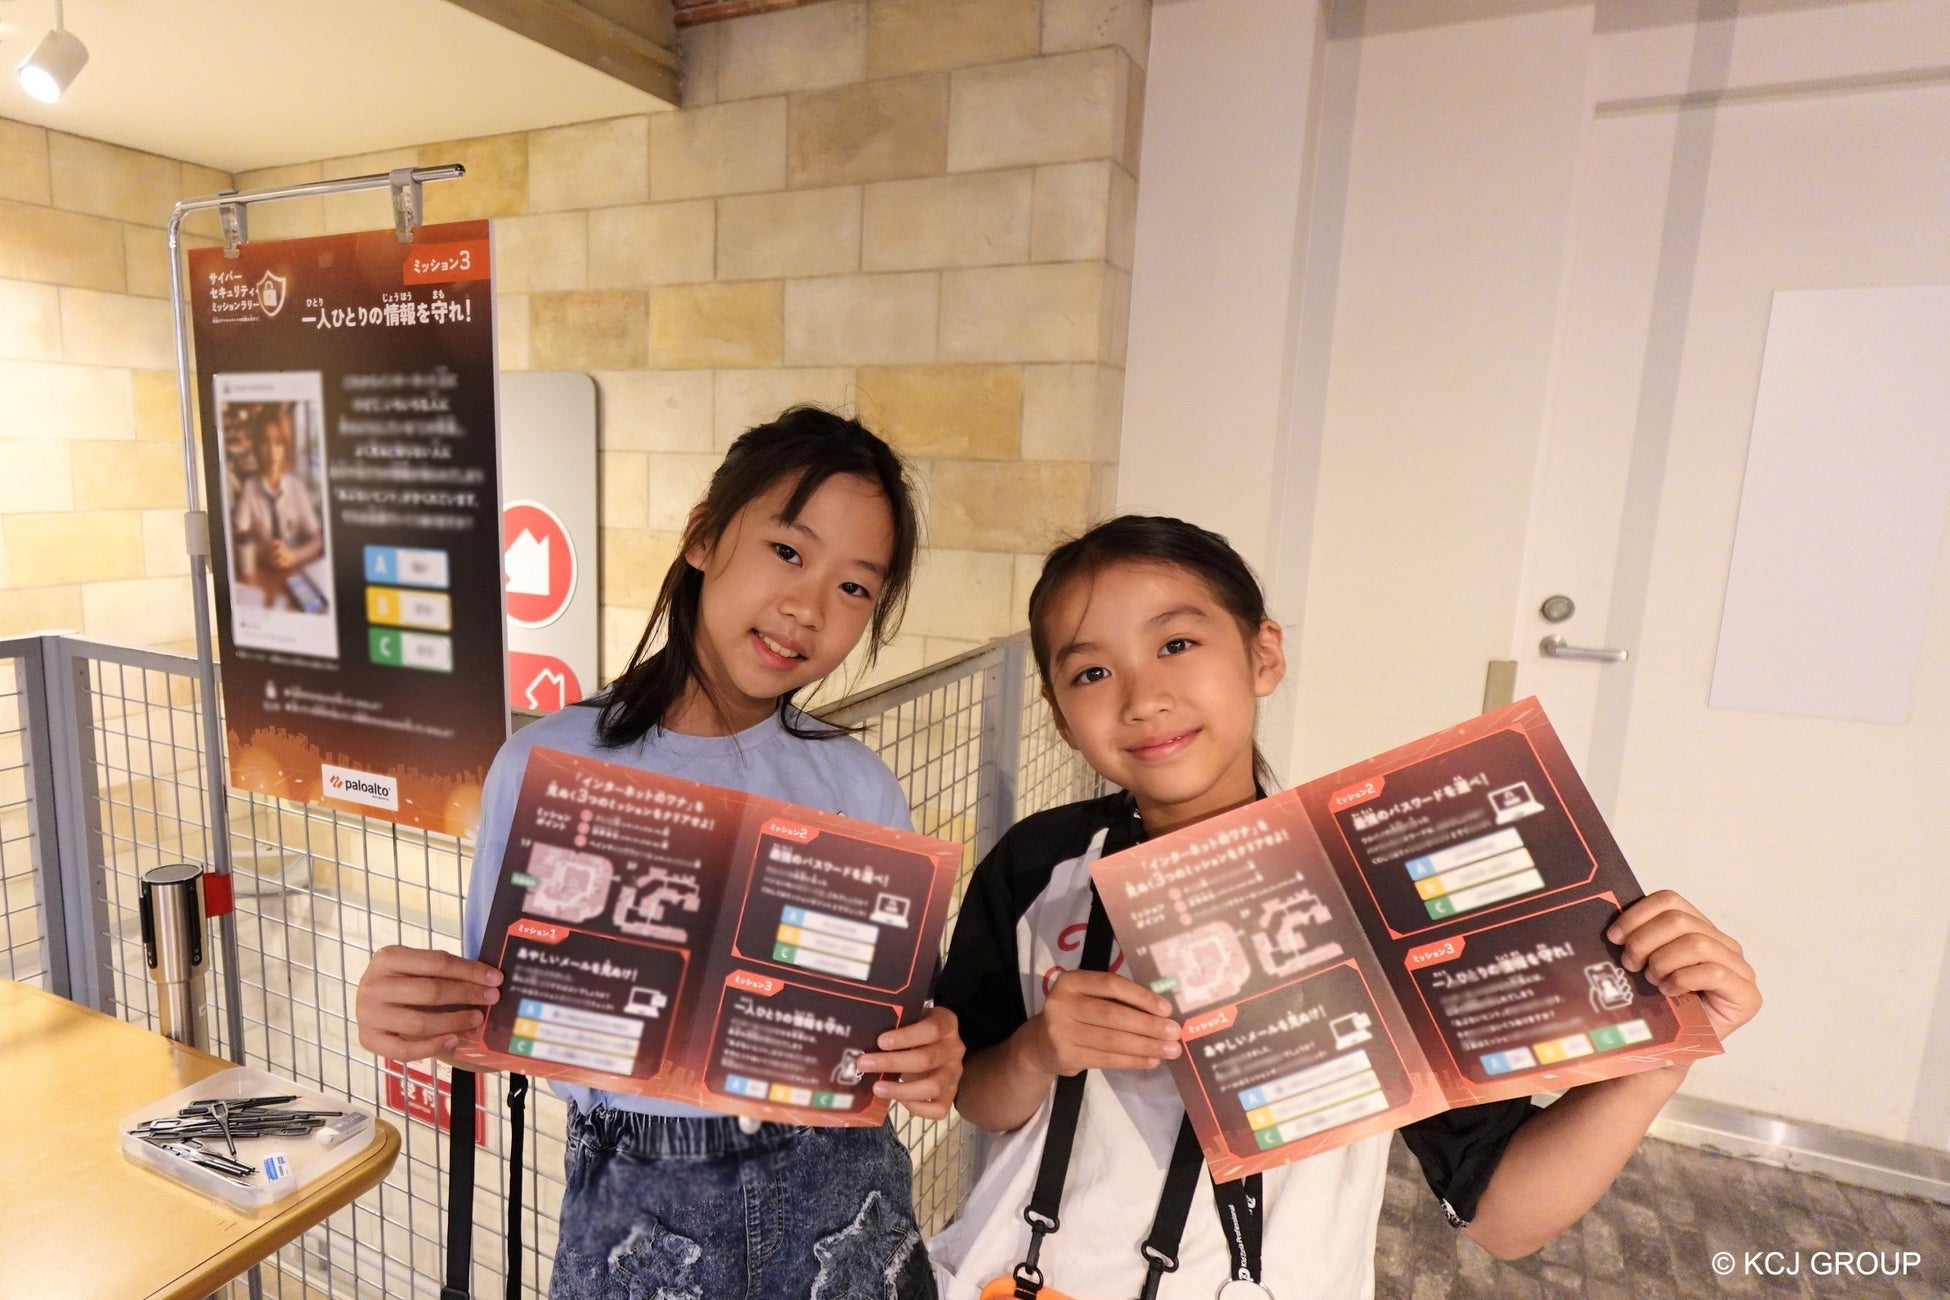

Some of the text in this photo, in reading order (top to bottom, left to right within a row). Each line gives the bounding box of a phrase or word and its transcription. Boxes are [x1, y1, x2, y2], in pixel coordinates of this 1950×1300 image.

[413, 250, 471, 274] ミッション3
[209, 270, 242, 285] サイバー
[306, 297, 324, 307] ひとり
[432, 289, 445, 300] まも
[212, 300, 260, 312] ミッションラリー
[302, 299, 471, 330] 一人ひとりの情報を守れ!
[375, 554, 388, 575] A
[380, 636, 391, 657] C
[345, 780, 389, 797] paloalto
[1336, 783, 1376, 805] ミッション2
[770, 823, 808, 840] ミッション2
[518, 923, 556, 939] ミッション1
[1412, 943, 1455, 963] ミッション3
[735, 975, 772, 991] ミッション3
[1189, 1012, 1229, 1034] ミッション1
